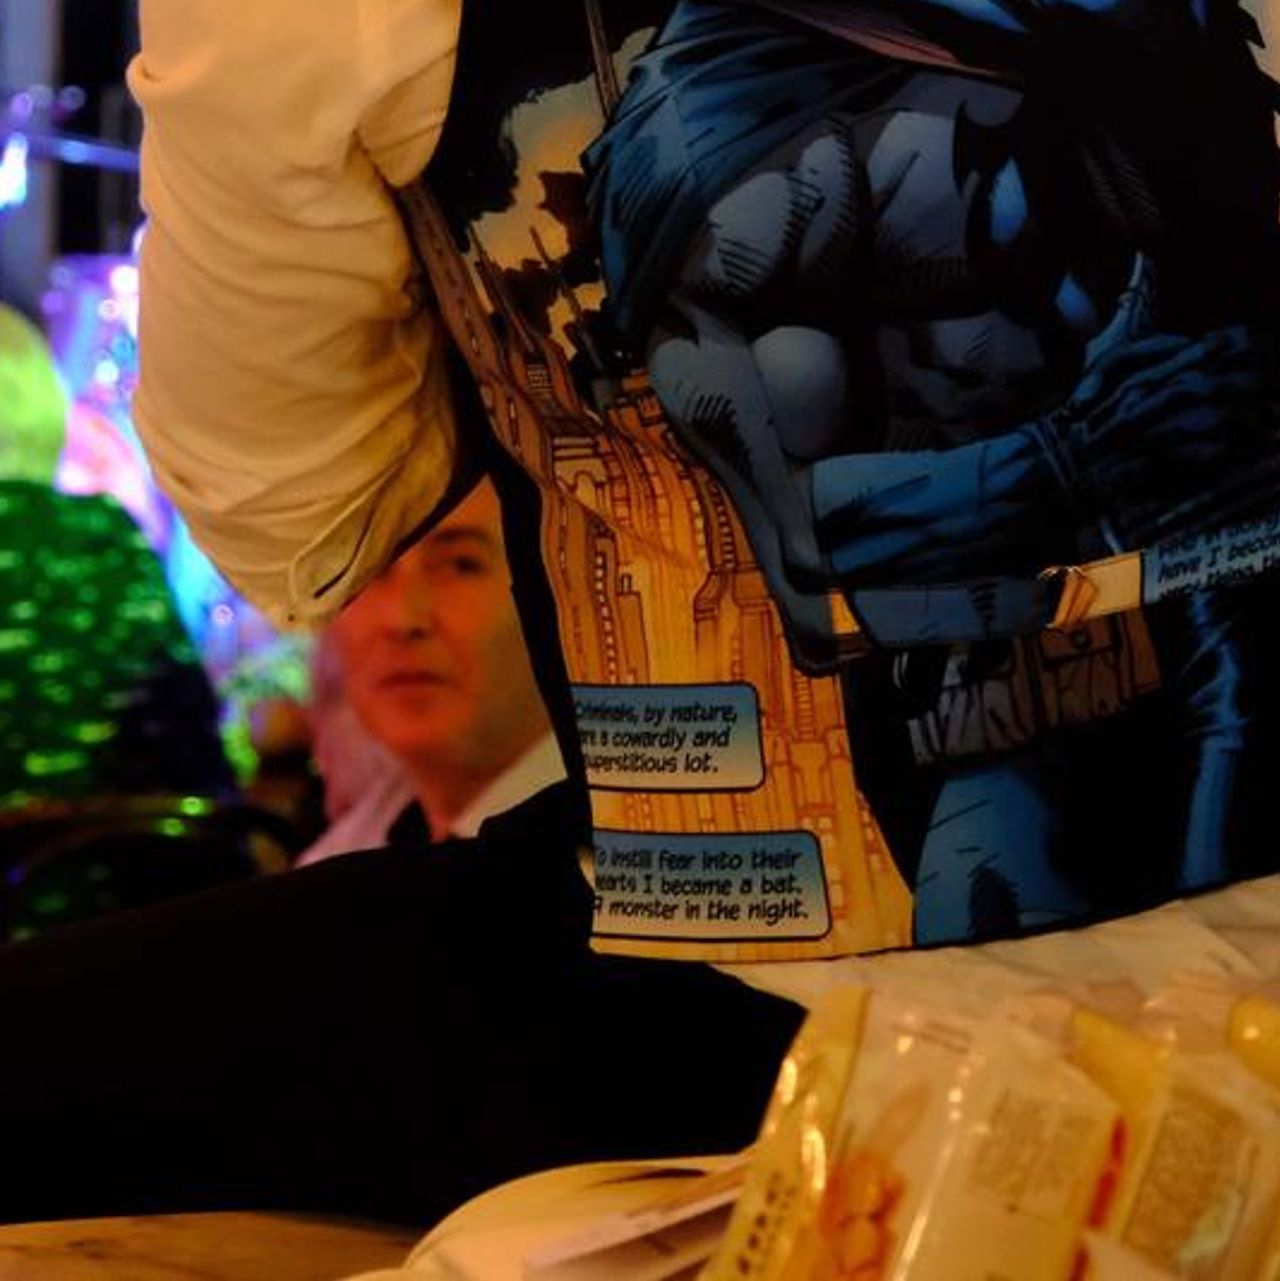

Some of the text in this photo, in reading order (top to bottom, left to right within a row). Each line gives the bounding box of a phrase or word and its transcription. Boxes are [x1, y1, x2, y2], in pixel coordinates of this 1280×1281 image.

[643, 703, 665, 727] by
[669, 700, 738, 724] nature,
[611, 727, 687, 752] cowardly
[693, 726, 732, 747] and
[585, 752, 719, 774] uperstitious lot.
[658, 849, 698, 871] fear
[701, 849, 743, 871] into
[751, 848, 804, 870] their
[642, 873, 654, 894] I
[660, 875, 733, 896] became
[739, 878, 753, 895] a
[760, 873, 803, 895] bat.
[608, 896, 681, 920] monster
[684, 899, 700, 920] in
[706, 899, 741, 922] the
[747, 898, 810, 927] night.
